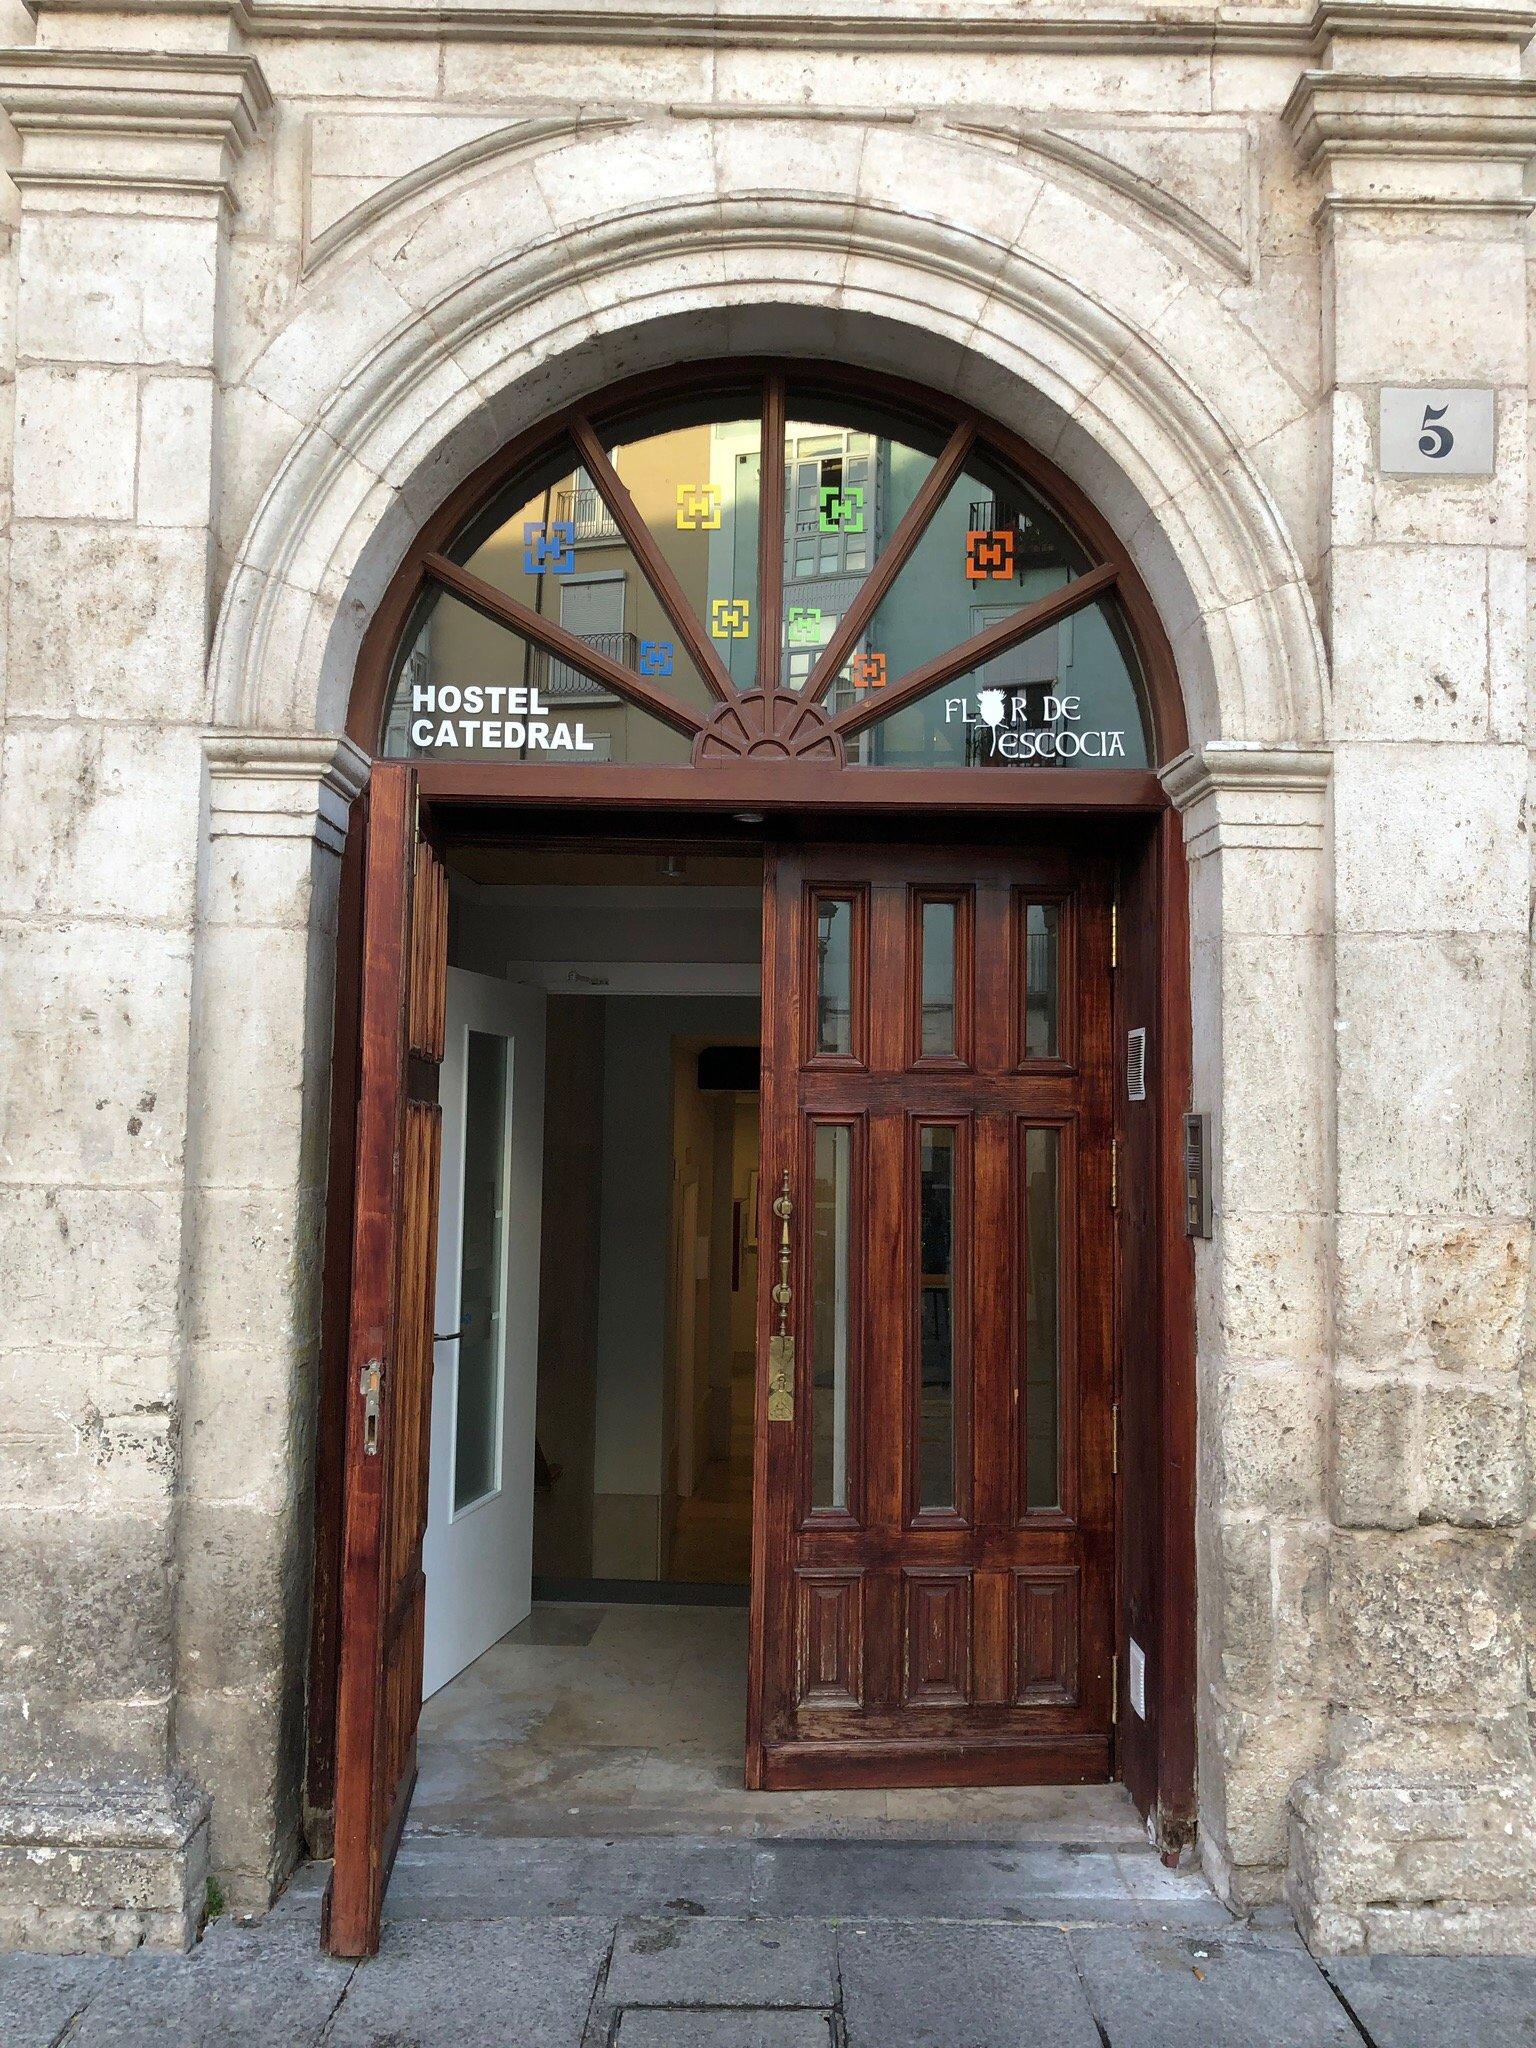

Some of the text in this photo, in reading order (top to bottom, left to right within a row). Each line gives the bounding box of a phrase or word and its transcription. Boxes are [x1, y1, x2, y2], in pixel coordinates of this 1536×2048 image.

[1418, 403, 1454, 459] 5
[412, 684, 549, 716] HOSTEL
[1043, 696, 1081, 722] DE
[411, 719, 595, 751] CATEDRAL
[998, 731, 1126, 759] ESCOCIA
